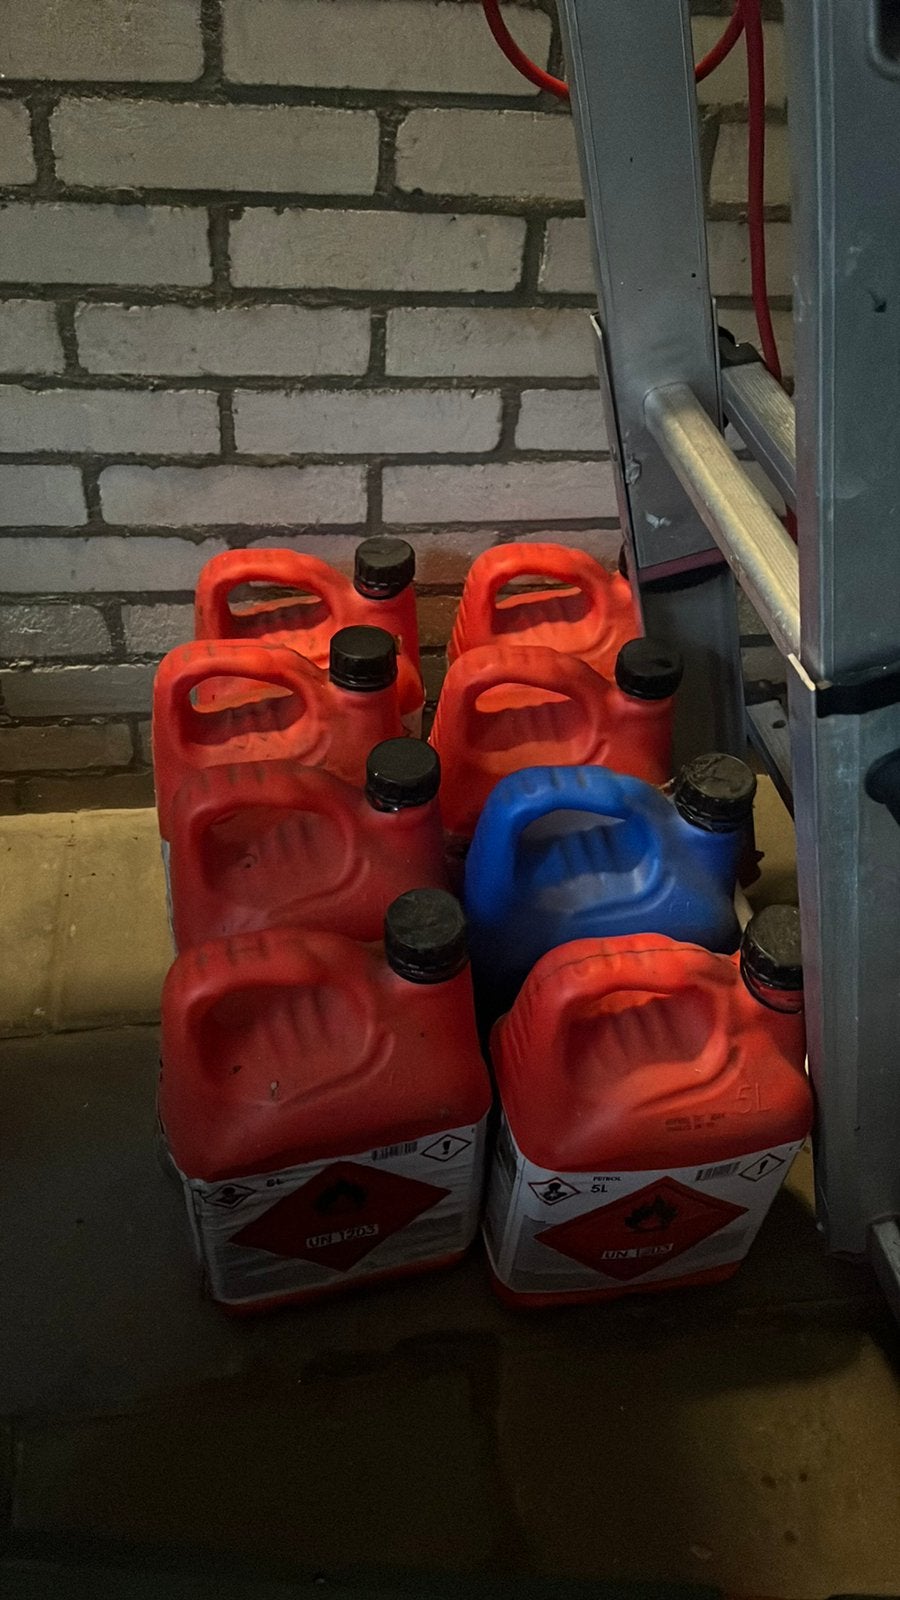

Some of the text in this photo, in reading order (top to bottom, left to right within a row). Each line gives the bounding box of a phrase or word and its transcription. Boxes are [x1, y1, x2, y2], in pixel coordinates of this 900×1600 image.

[735, 1083, 773, 1114] 5L
[591, 1184, 608, 1193] 5L
[309, 1233, 332, 1248] UN
[605, 1250, 628, 1260] UN
